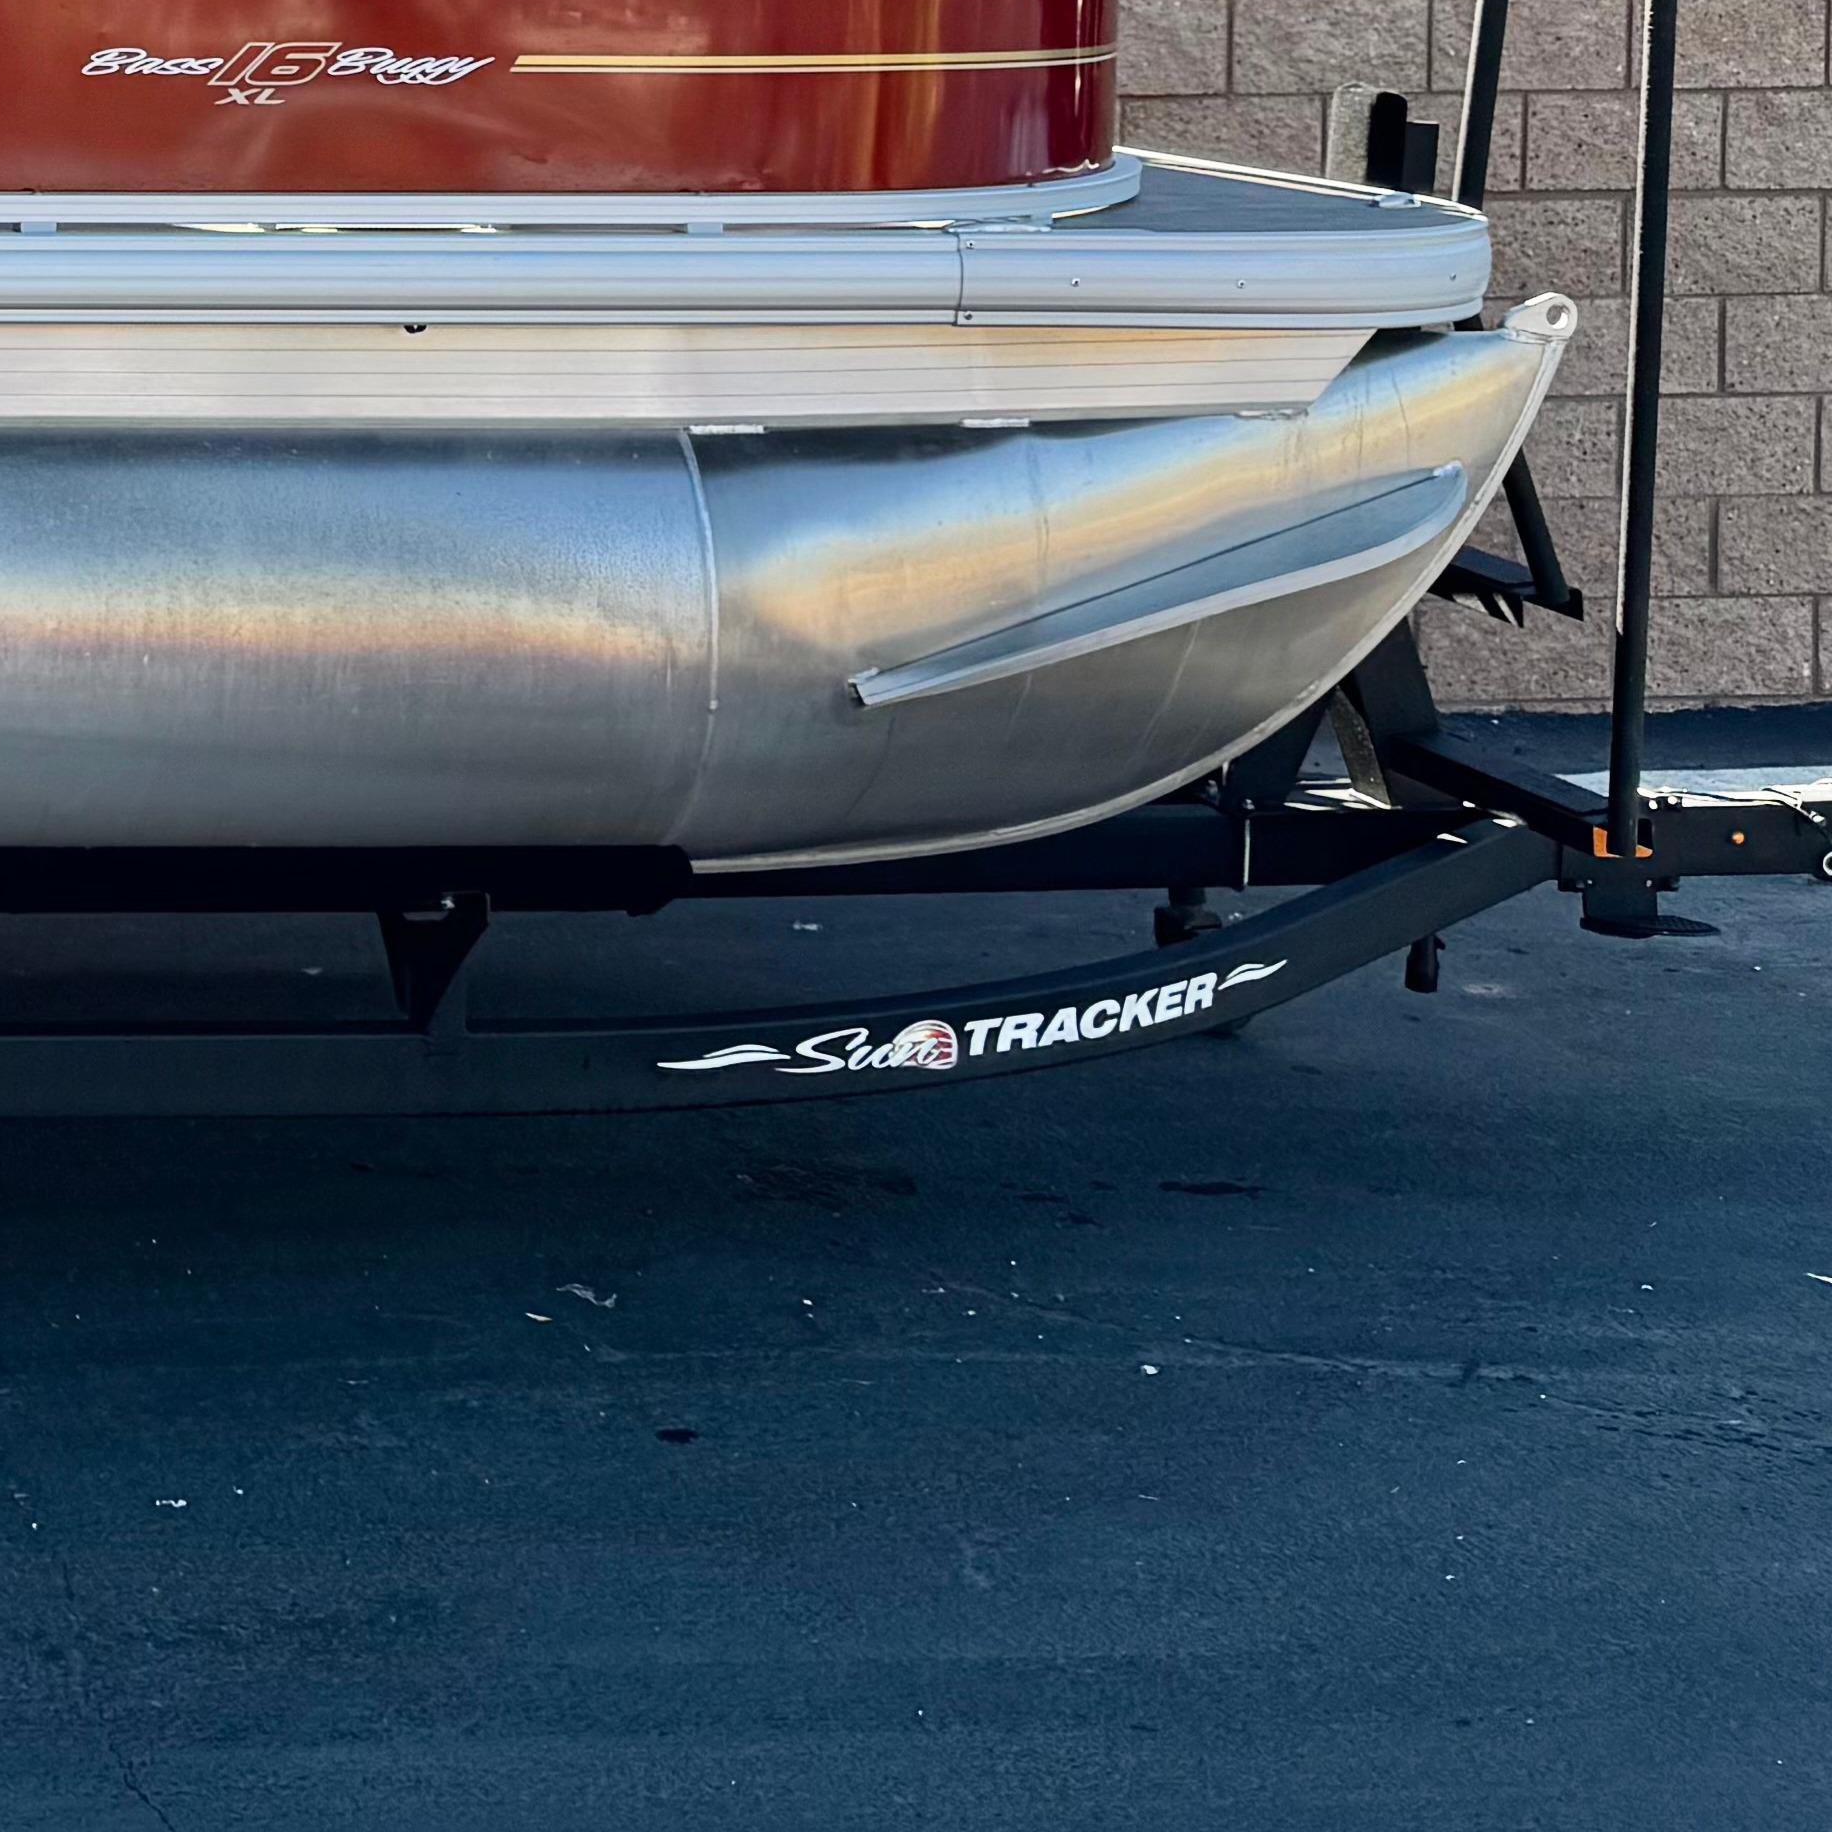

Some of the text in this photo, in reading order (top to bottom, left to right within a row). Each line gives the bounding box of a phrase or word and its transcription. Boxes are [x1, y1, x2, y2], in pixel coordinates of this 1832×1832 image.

[81, 41, 495, 86] Bass 16 Buggy
[214, 88, 286, 105] XL
[775, 972, 1218, 1074] Sun TRACKER
